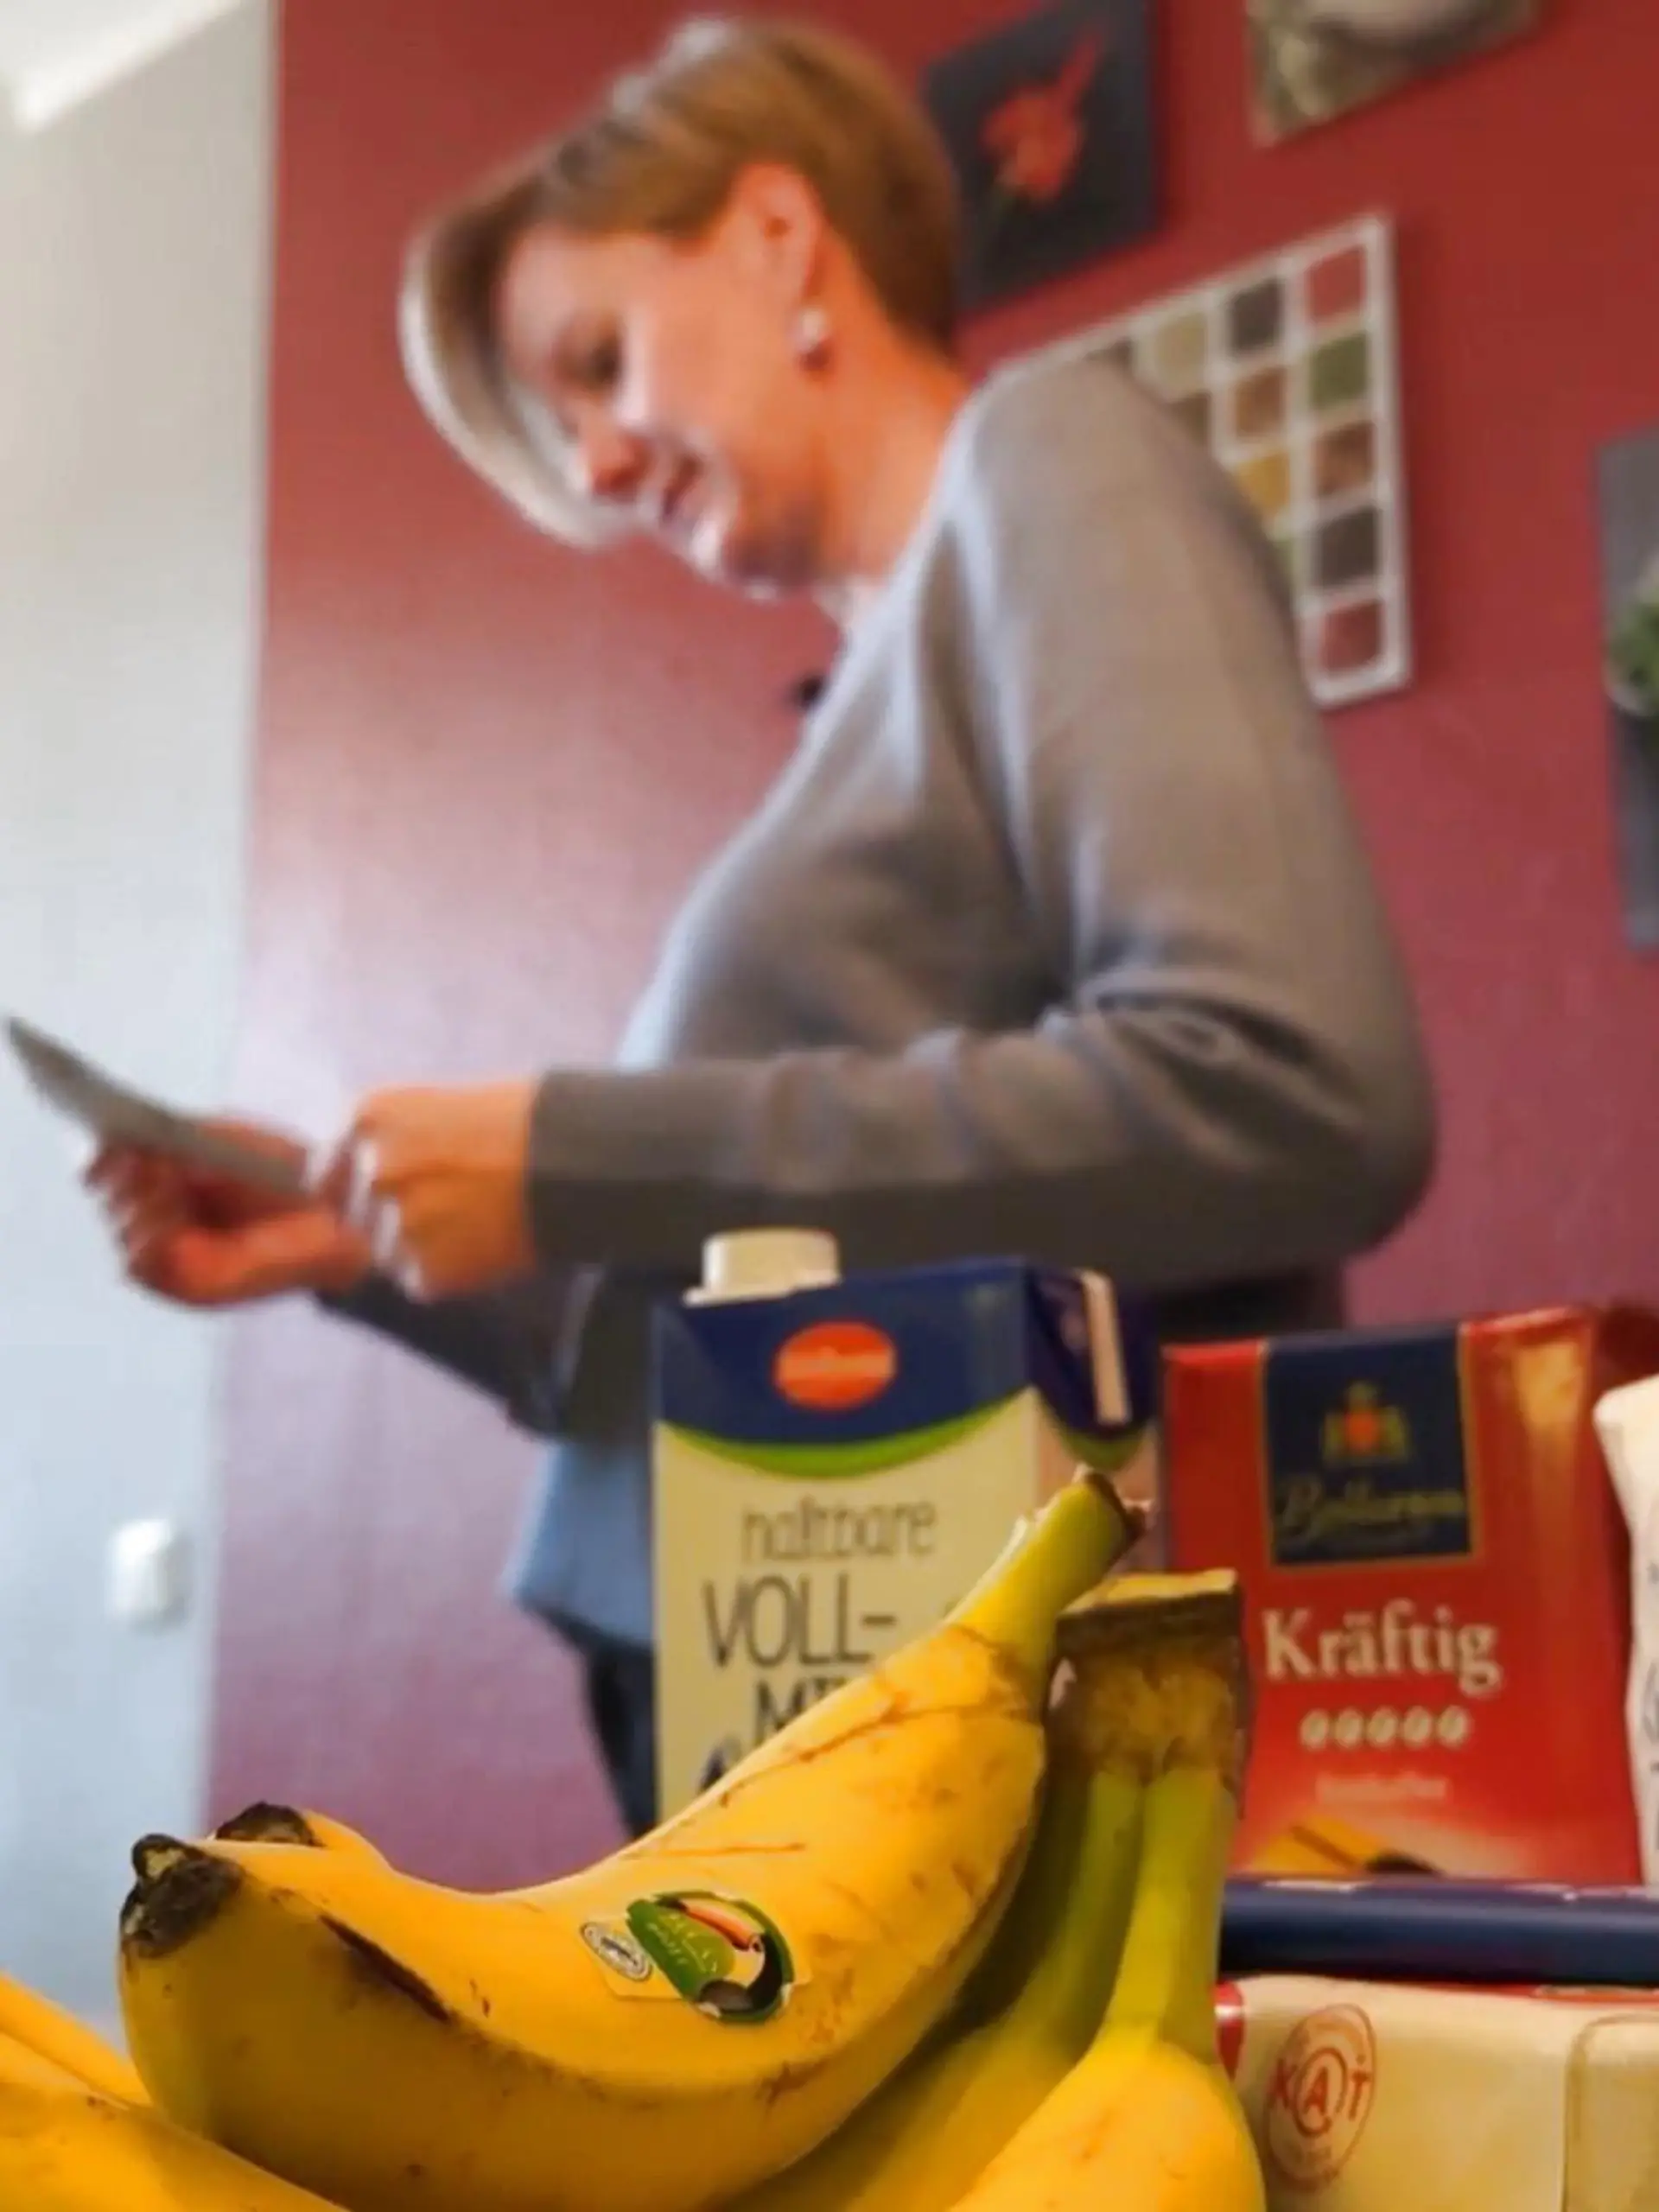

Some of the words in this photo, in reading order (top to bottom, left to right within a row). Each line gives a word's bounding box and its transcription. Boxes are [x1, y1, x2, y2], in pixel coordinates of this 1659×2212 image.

[701, 1573, 896, 1666] VOLL-
[1262, 1598, 1503, 1697] Kräftig
[1267, 2057, 1371, 2122] KAT
